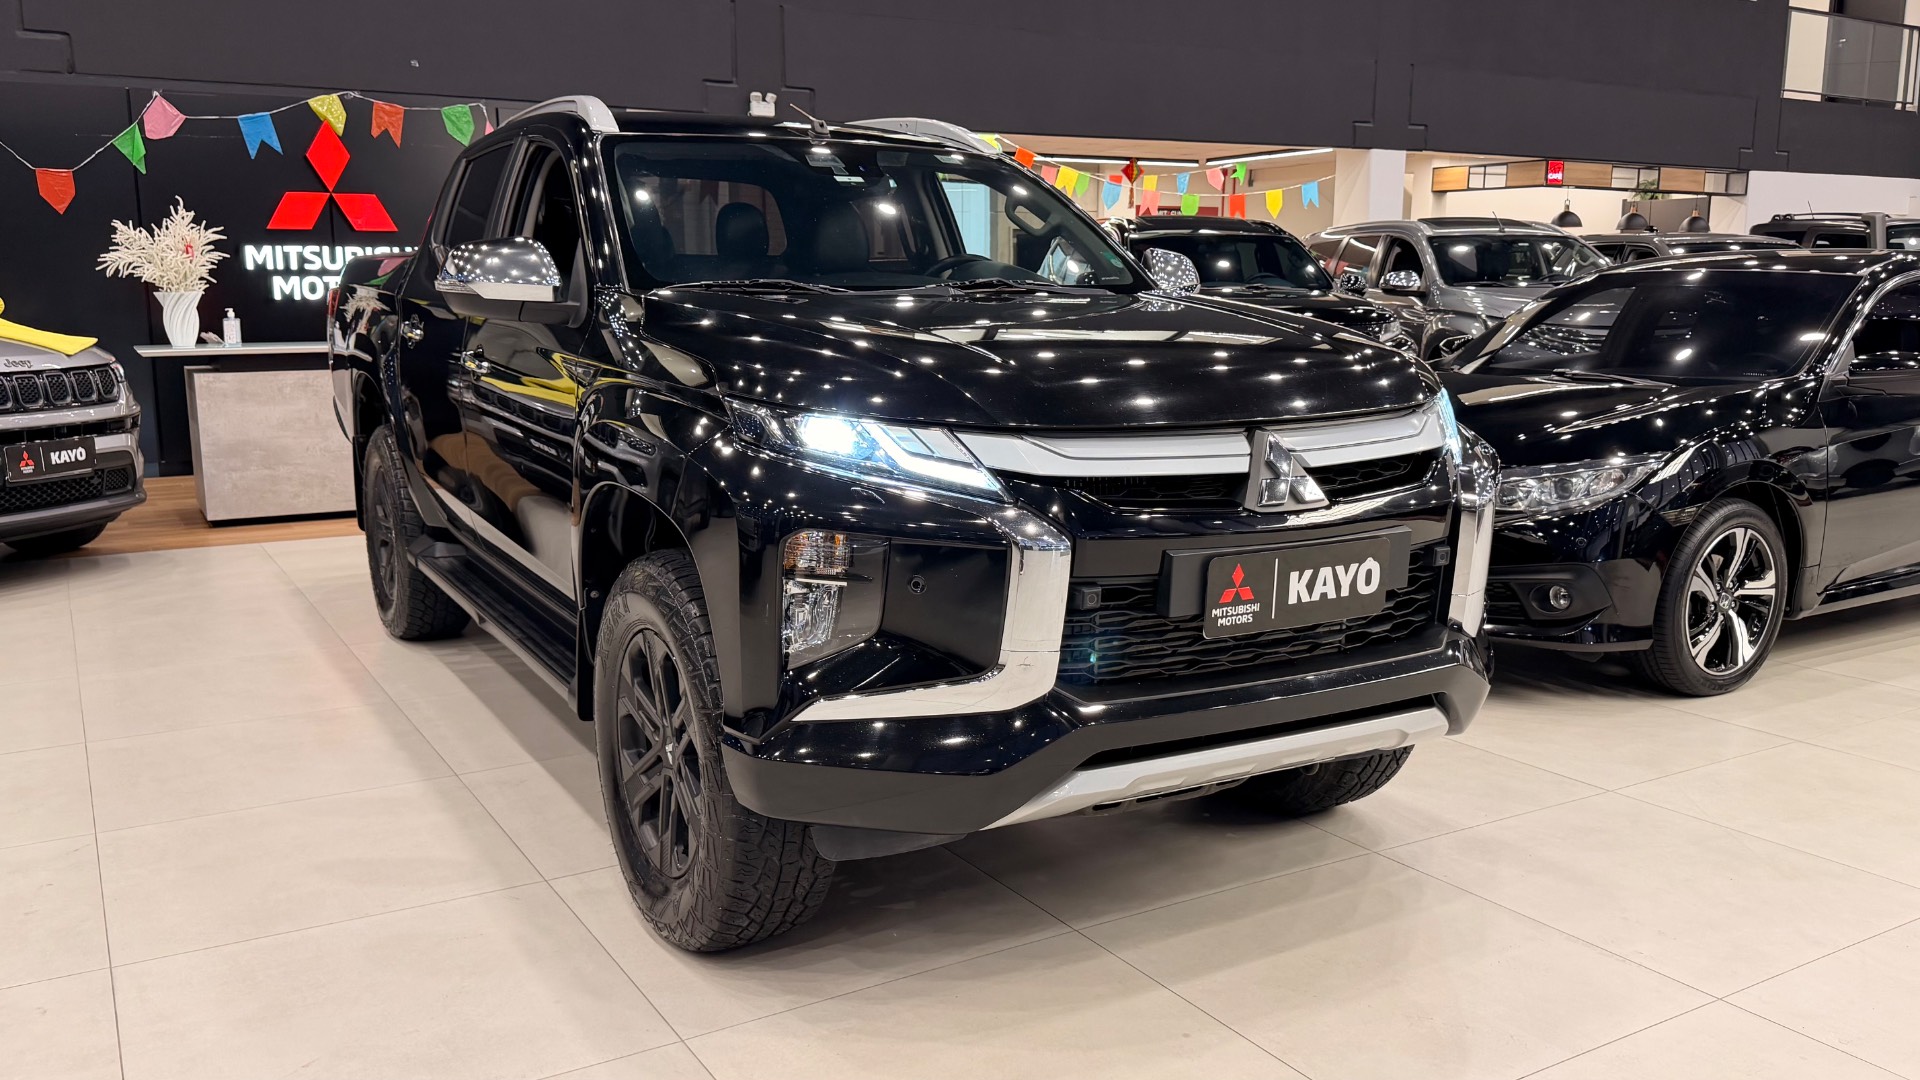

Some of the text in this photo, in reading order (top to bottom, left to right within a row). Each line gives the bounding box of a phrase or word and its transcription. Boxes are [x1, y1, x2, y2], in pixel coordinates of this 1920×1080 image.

[272, 275, 341, 301] MOT
[1212, 602, 1260, 618] MITSUBISHI
[1217, 613, 1253, 627] MOTORS
